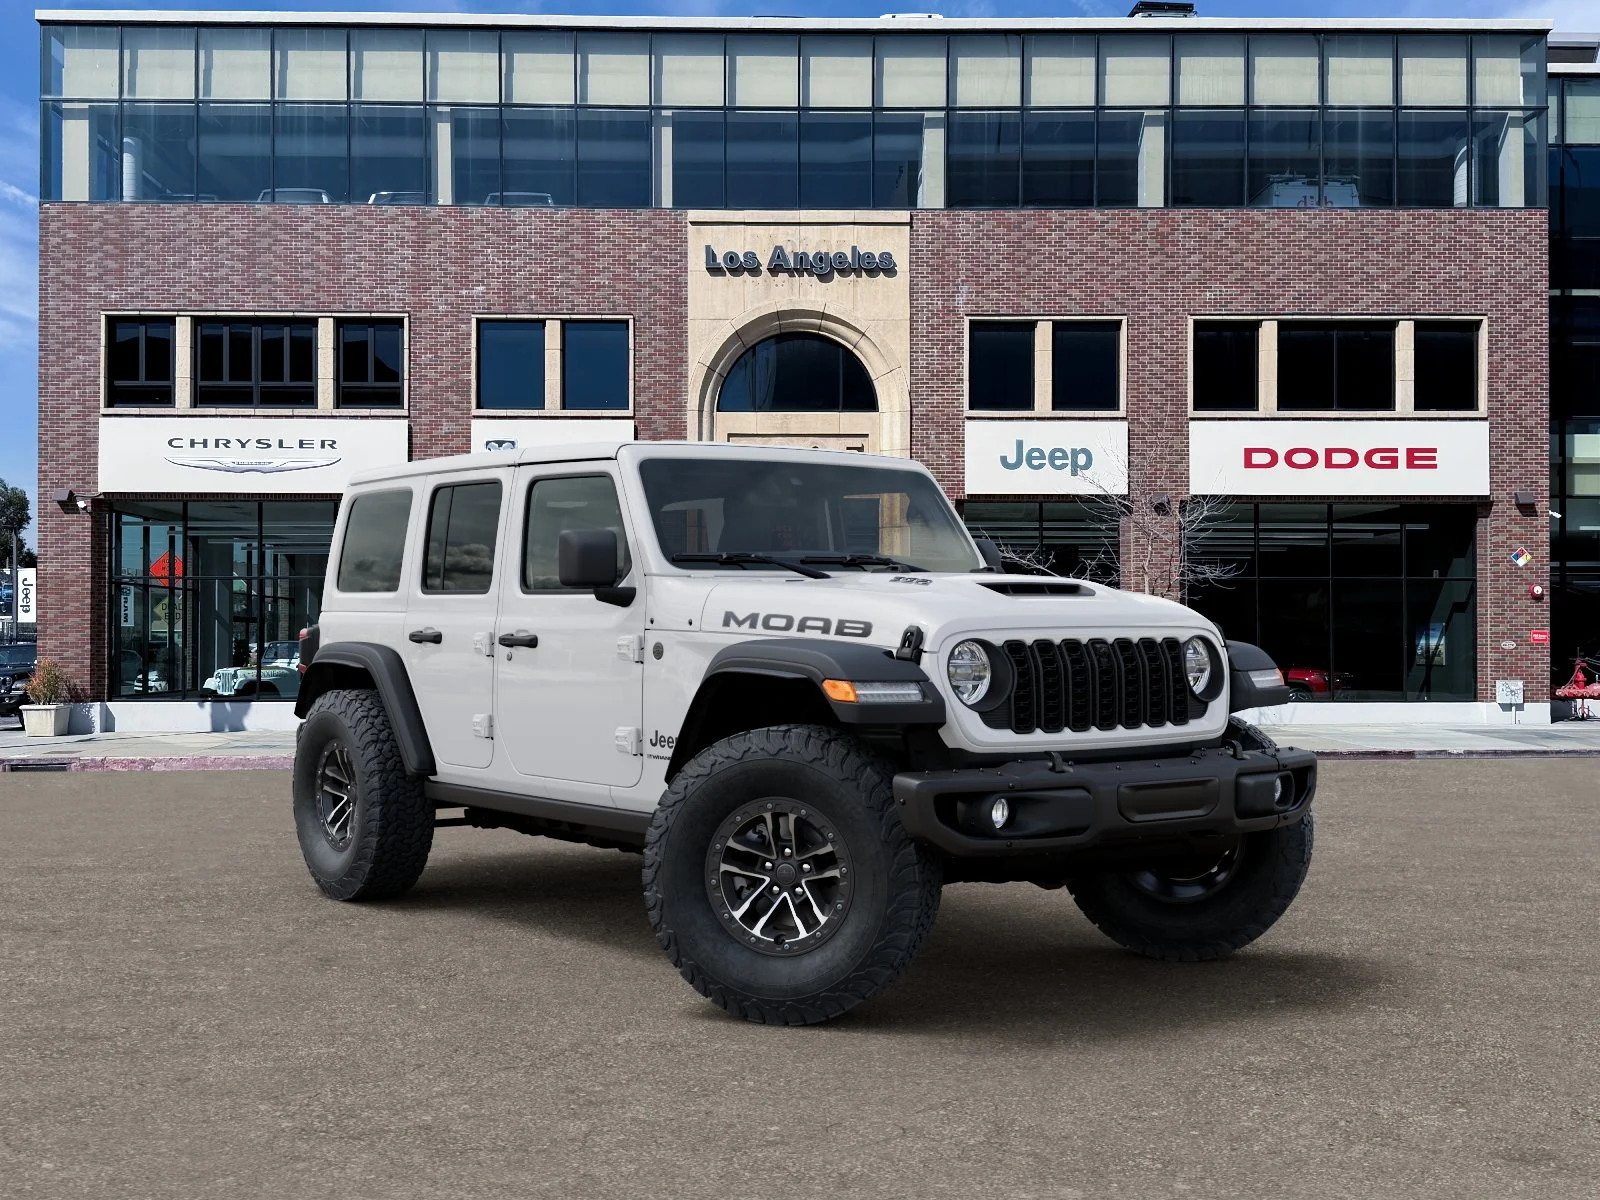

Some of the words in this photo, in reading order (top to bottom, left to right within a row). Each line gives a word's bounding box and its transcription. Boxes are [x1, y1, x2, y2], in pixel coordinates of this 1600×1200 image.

[704, 244, 758, 269] Los
[767, 244, 895, 275] Angeles
[167, 437, 338, 450] CHRYSLER
[999, 439, 1094, 476] Jeep
[1243, 447, 1438, 470] DODGE
[20, 577, 34, 614] Jeep
[721, 610, 874, 638] MOAB
[649, 729, 678, 749] Jee
